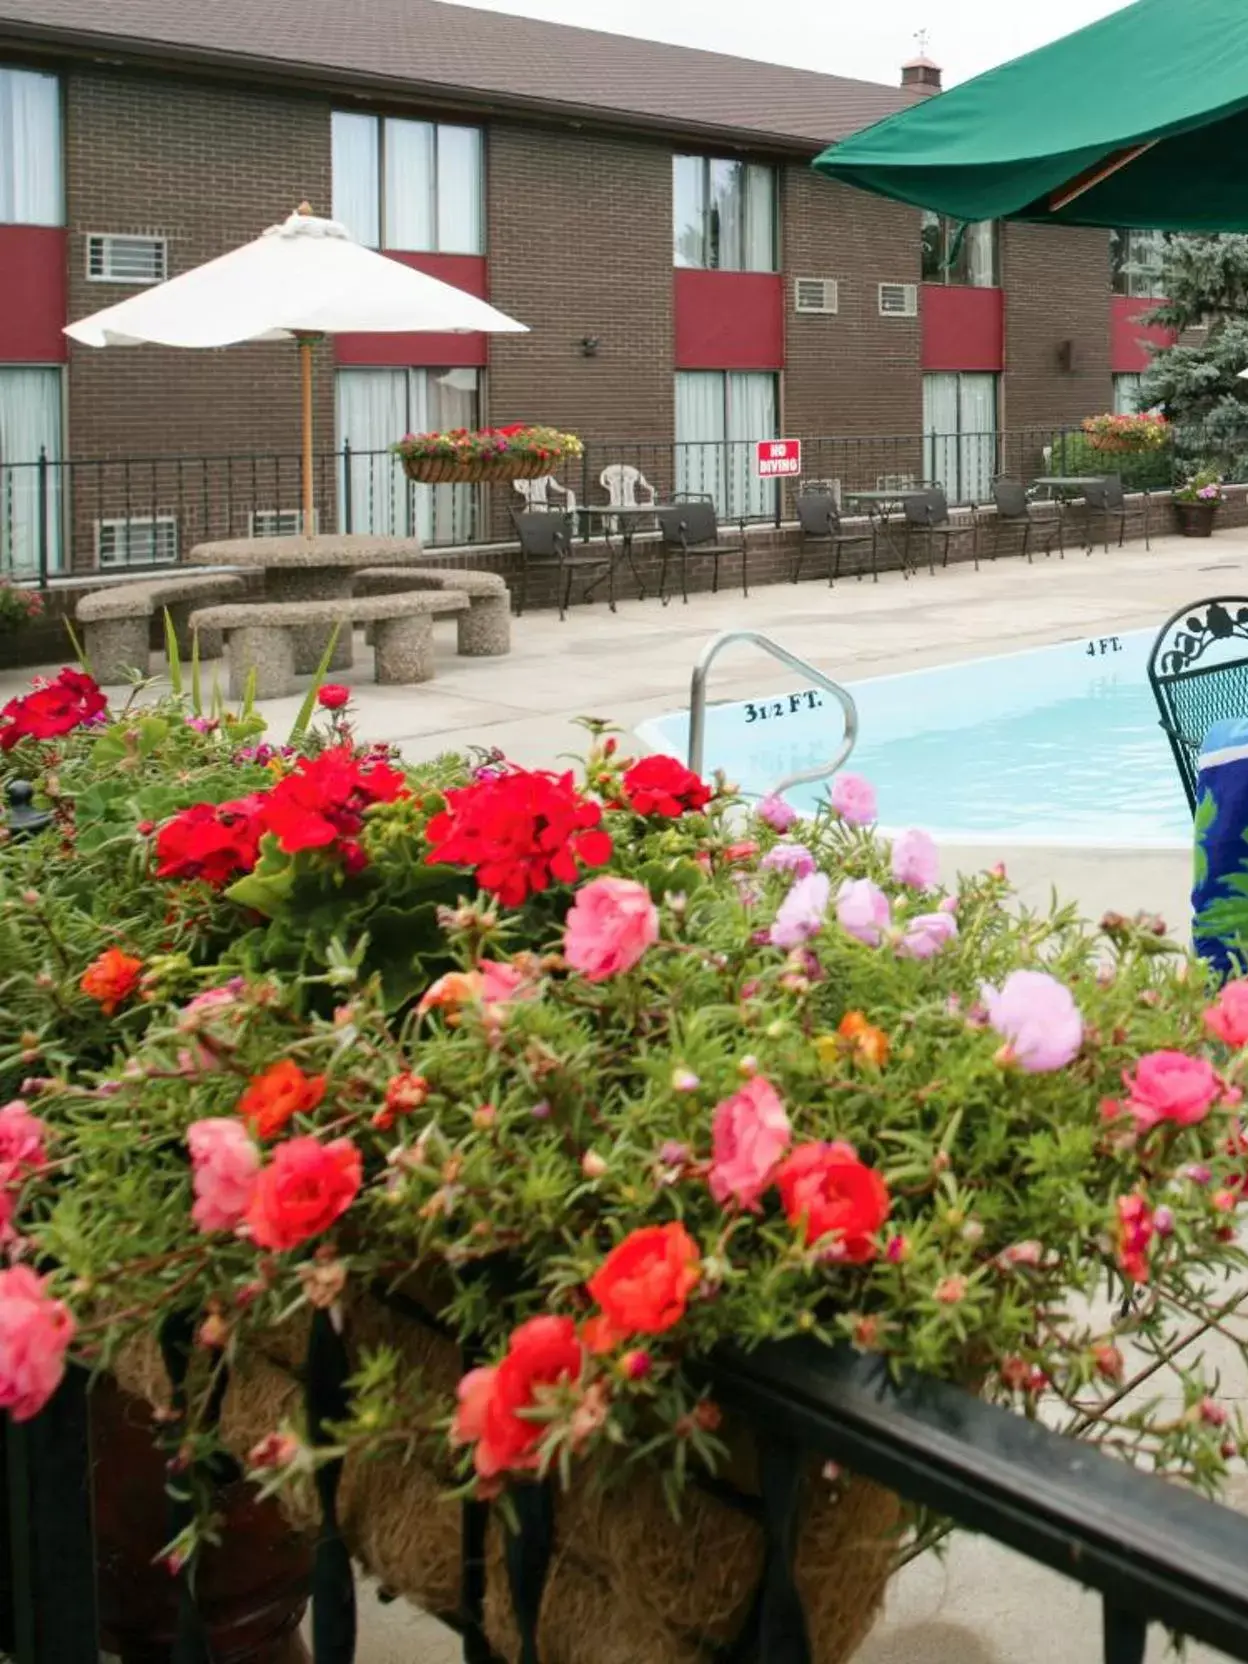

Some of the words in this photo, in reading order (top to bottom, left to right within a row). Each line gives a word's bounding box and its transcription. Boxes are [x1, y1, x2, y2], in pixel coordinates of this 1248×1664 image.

[770, 443, 787, 457] NO
[760, 458, 798, 474] DIVING
[1086, 640, 1095, 656] 4
[787, 689, 823, 713] FT.
